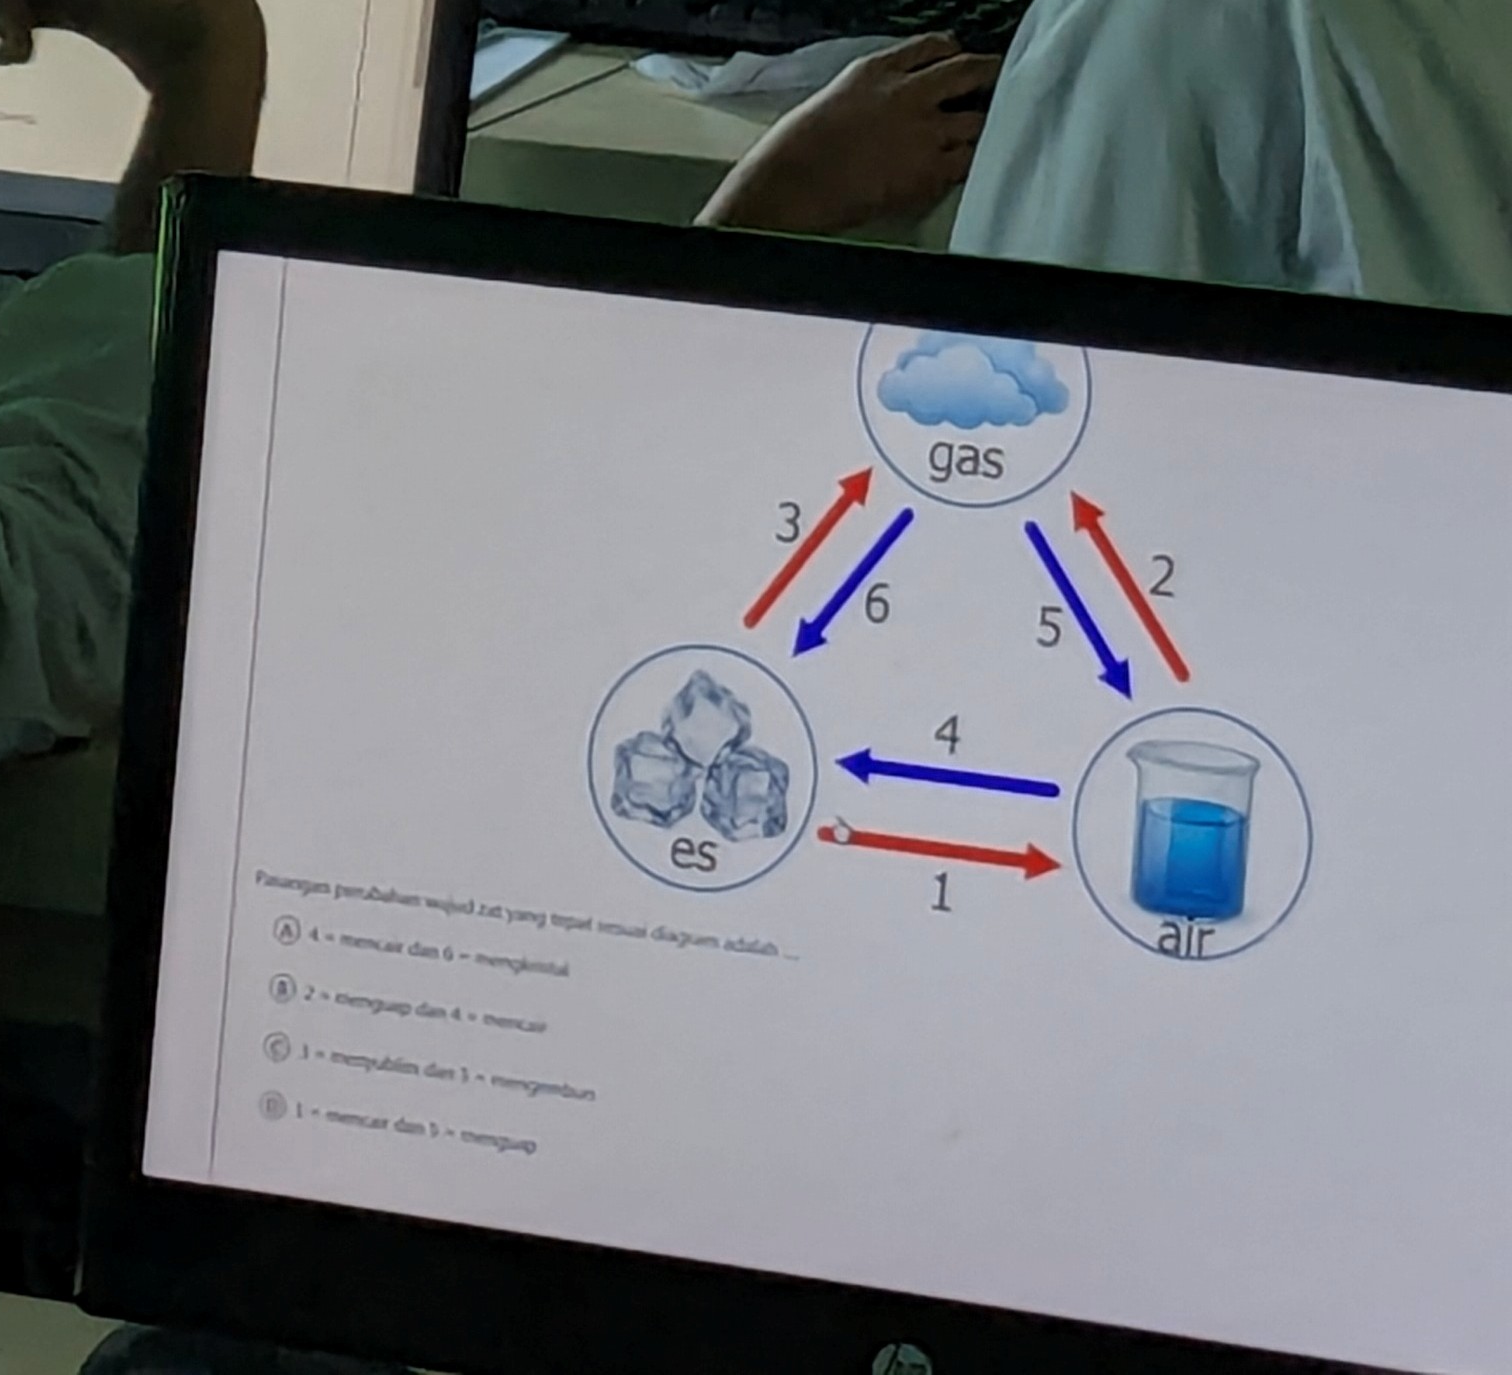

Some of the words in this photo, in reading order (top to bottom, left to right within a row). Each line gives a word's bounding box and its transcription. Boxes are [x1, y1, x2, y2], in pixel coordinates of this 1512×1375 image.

[929, 441, 1004, 483] gas
[775, 501, 801, 543] 3
[1150, 556, 1176, 596] 2
[865, 583, 890, 623] 6
[1038, 607, 1063, 648] 5
[934, 715, 960, 754] 4
[670, 838, 718, 873] es
[932, 874, 952, 912] 1
[1157, 920, 1215, 959] air
